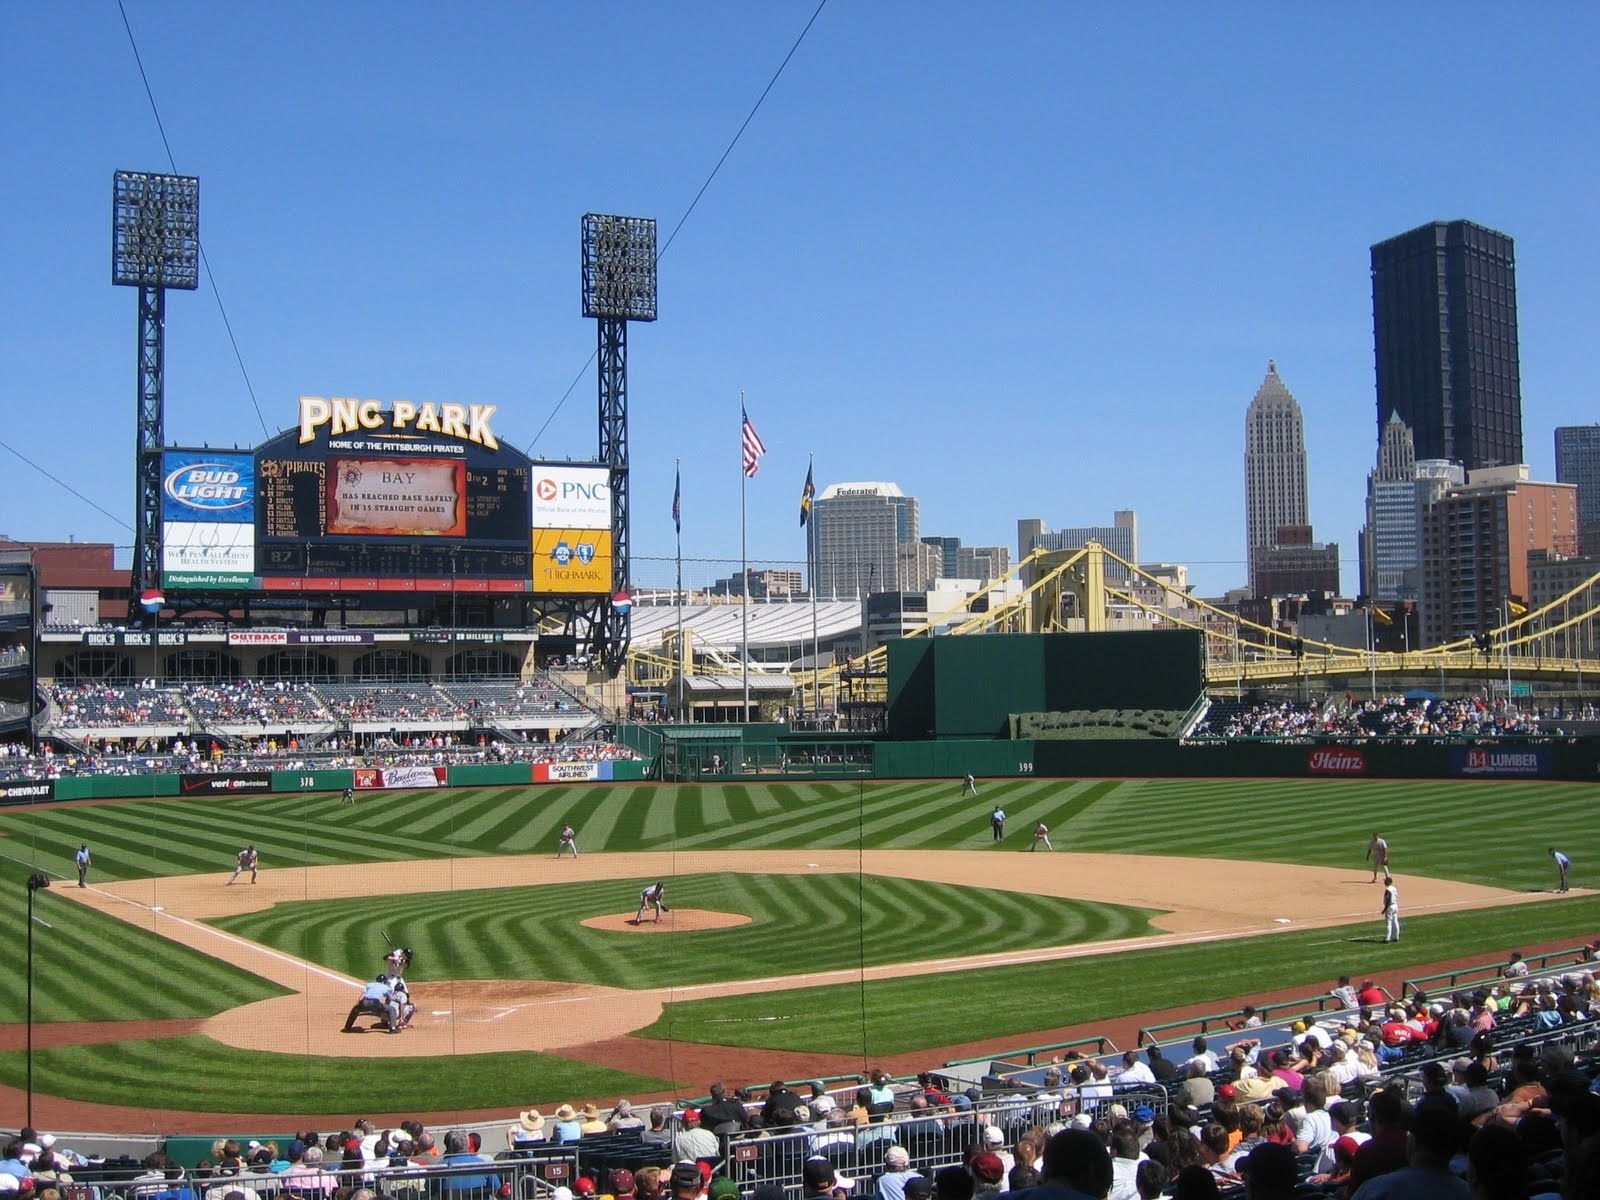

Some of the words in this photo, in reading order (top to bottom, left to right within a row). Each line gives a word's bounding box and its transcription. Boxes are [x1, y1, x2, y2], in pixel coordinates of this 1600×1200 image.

[300, 397, 384, 444] PNC
[393, 401, 499, 450] PARK
[329, 441, 352, 449] HOME
[366, 442, 382, 450] THE
[383, 443, 432, 452] PITTSBURGH
[433, 445, 464, 453] PIRATES
[286, 461, 326, 478] PIRATES
[188, 470, 240, 484] BUD
[382, 472, 415, 484] BAY
[482, 476, 488, 485] 2
[178, 485, 248, 499] LIGHT
[561, 482, 606, 500] PNC
[837, 487, 877, 496] Federated
[271, 551, 291, 562] 87
[501, 555, 525, 566] 2:45
[168, 575, 209, 583] Distinguished
[210, 576, 217, 584] by
[217, 575, 250, 583] Excellence
[545, 568, 601, 580] HIGHMARK
[88, 633, 115, 643] DICK'S
[124, 633, 150, 643] DICK'S
[158, 633, 184, 643] DICK'S
[1309, 752, 1364, 770] Heinz
[1469, 752, 1486, 767] 84
[1491, 754, 1537, 767] LUMBER
[1019, 763, 1033, 772] 399
[300, 777, 314, 787] 378
[8, 785, 50, 797] CHEVROLET
[552, 1167, 561, 1175] 15
